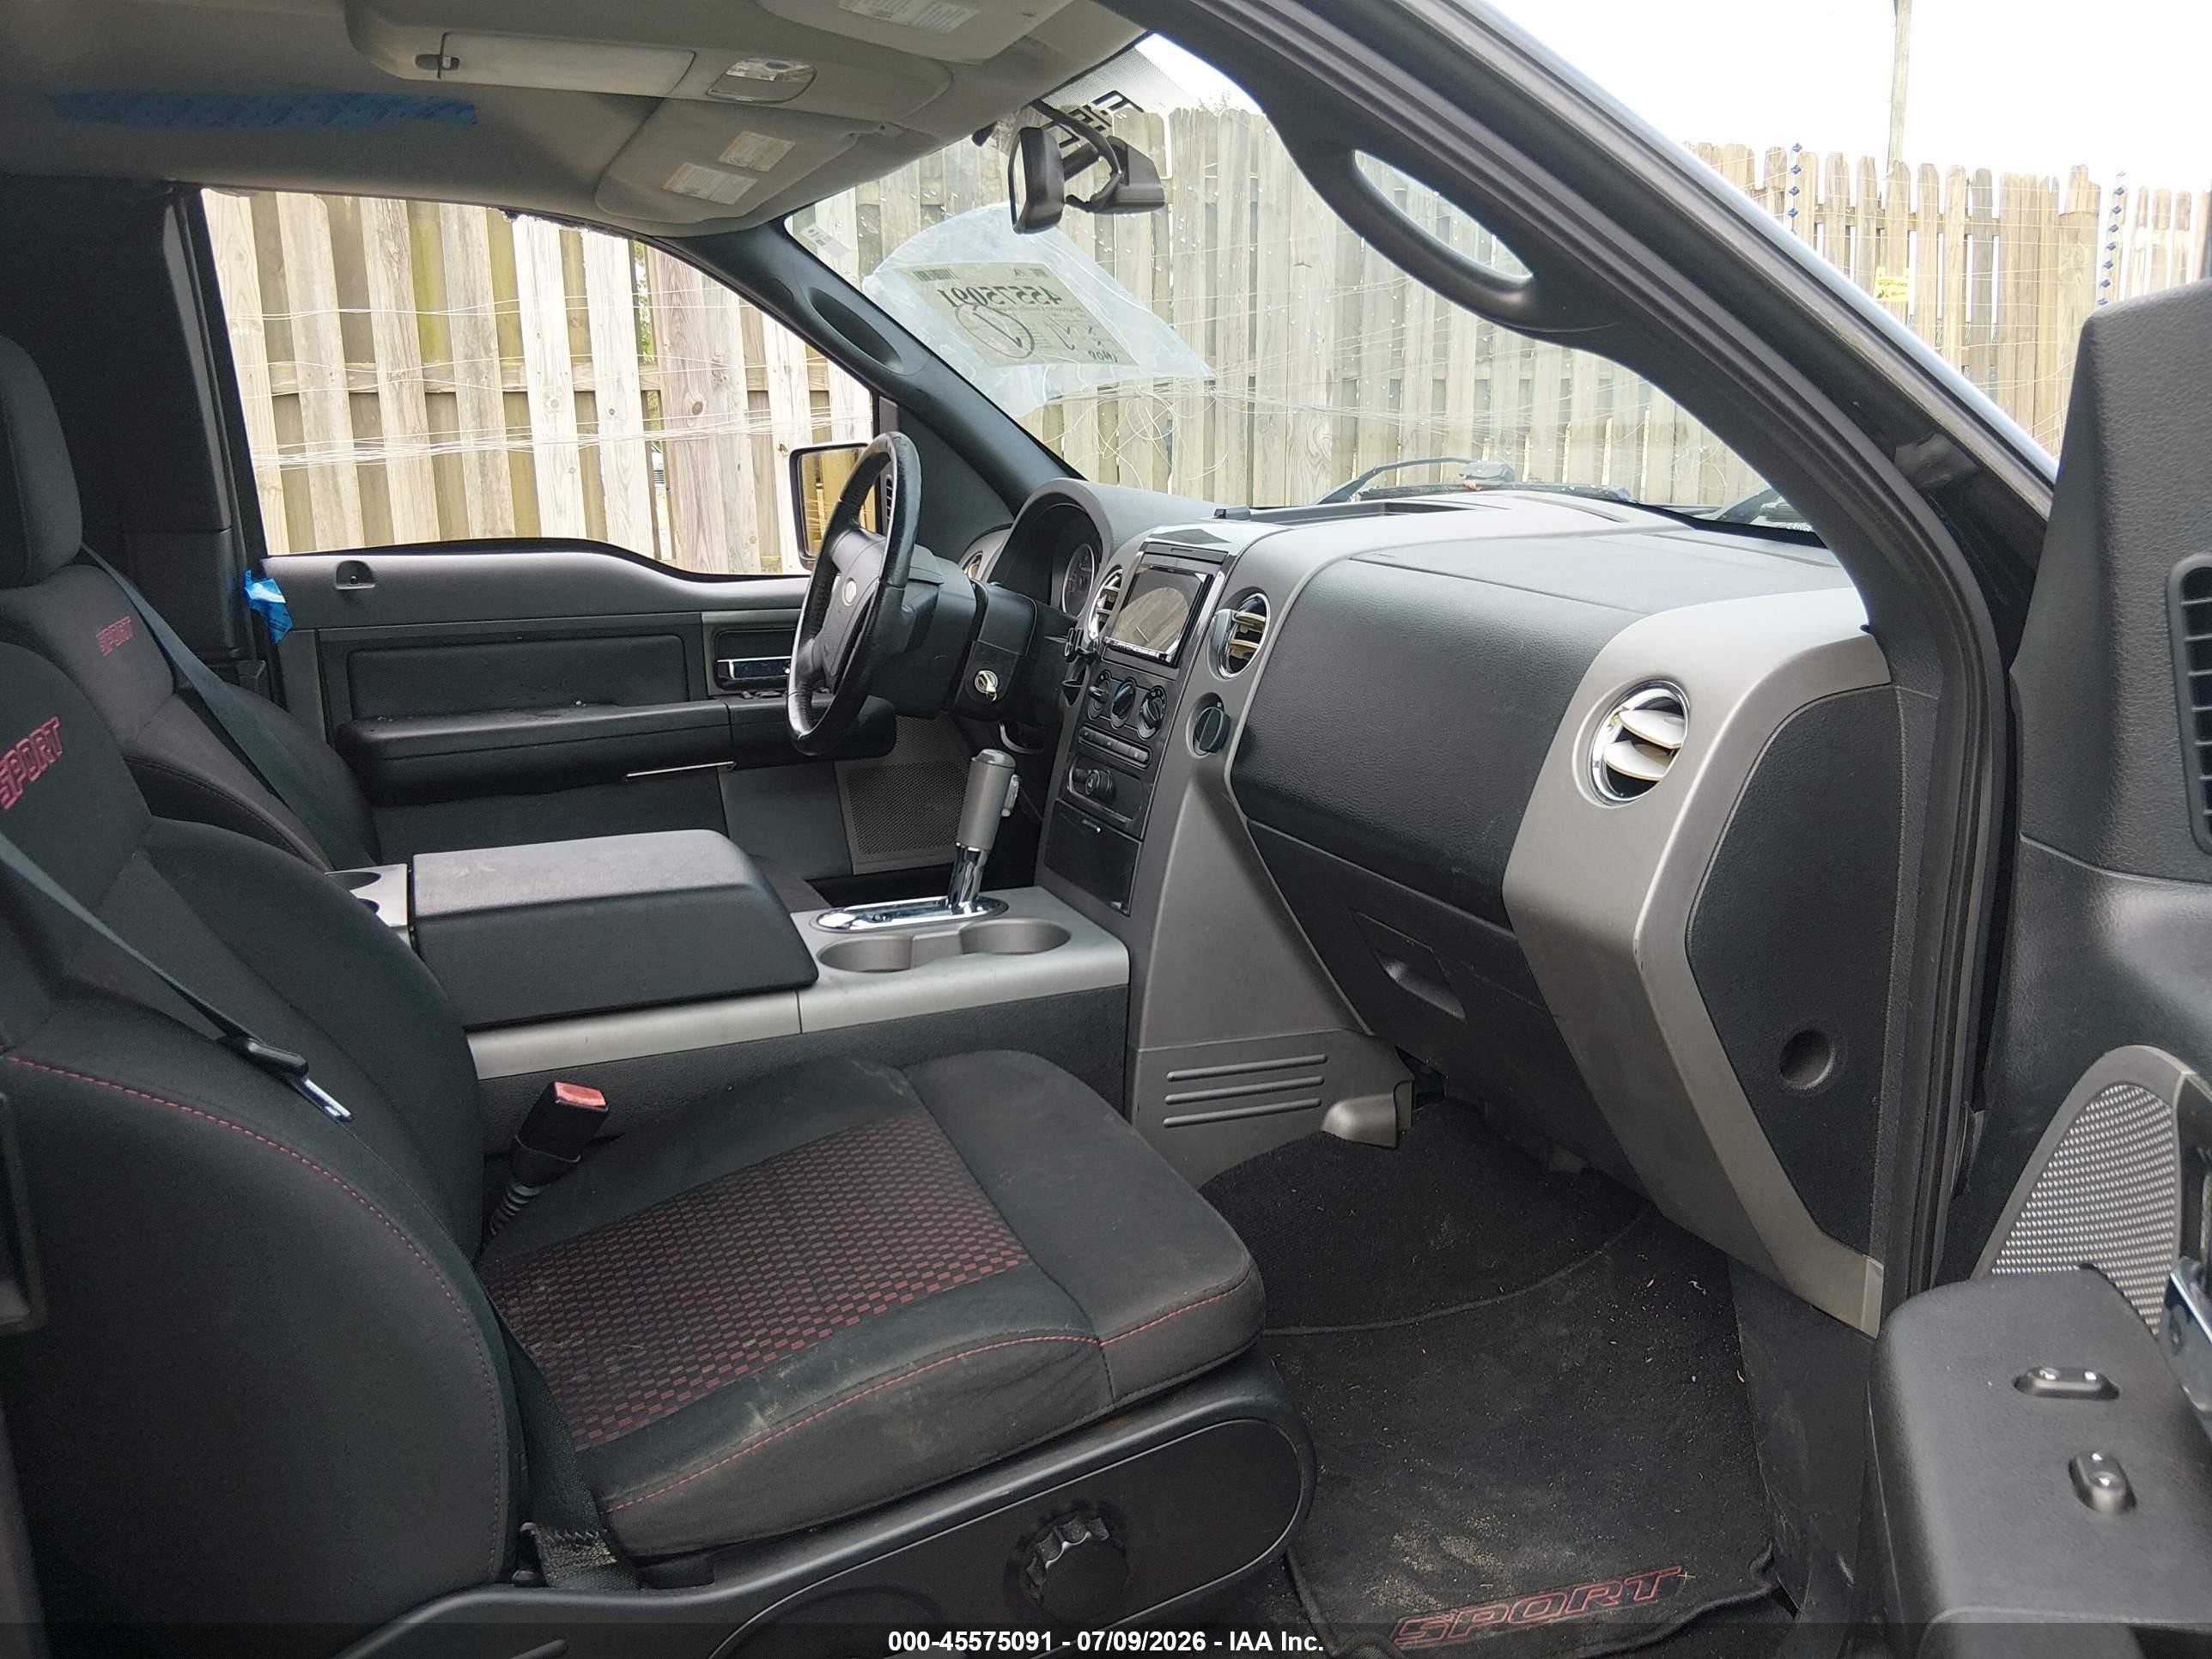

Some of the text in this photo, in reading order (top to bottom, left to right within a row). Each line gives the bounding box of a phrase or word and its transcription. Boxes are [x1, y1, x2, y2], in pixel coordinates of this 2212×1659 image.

[96, 615, 134, 657] SPORT
[0, 715, 63, 811] SPORT
[1394, 1565, 1683, 1646] SPORT
